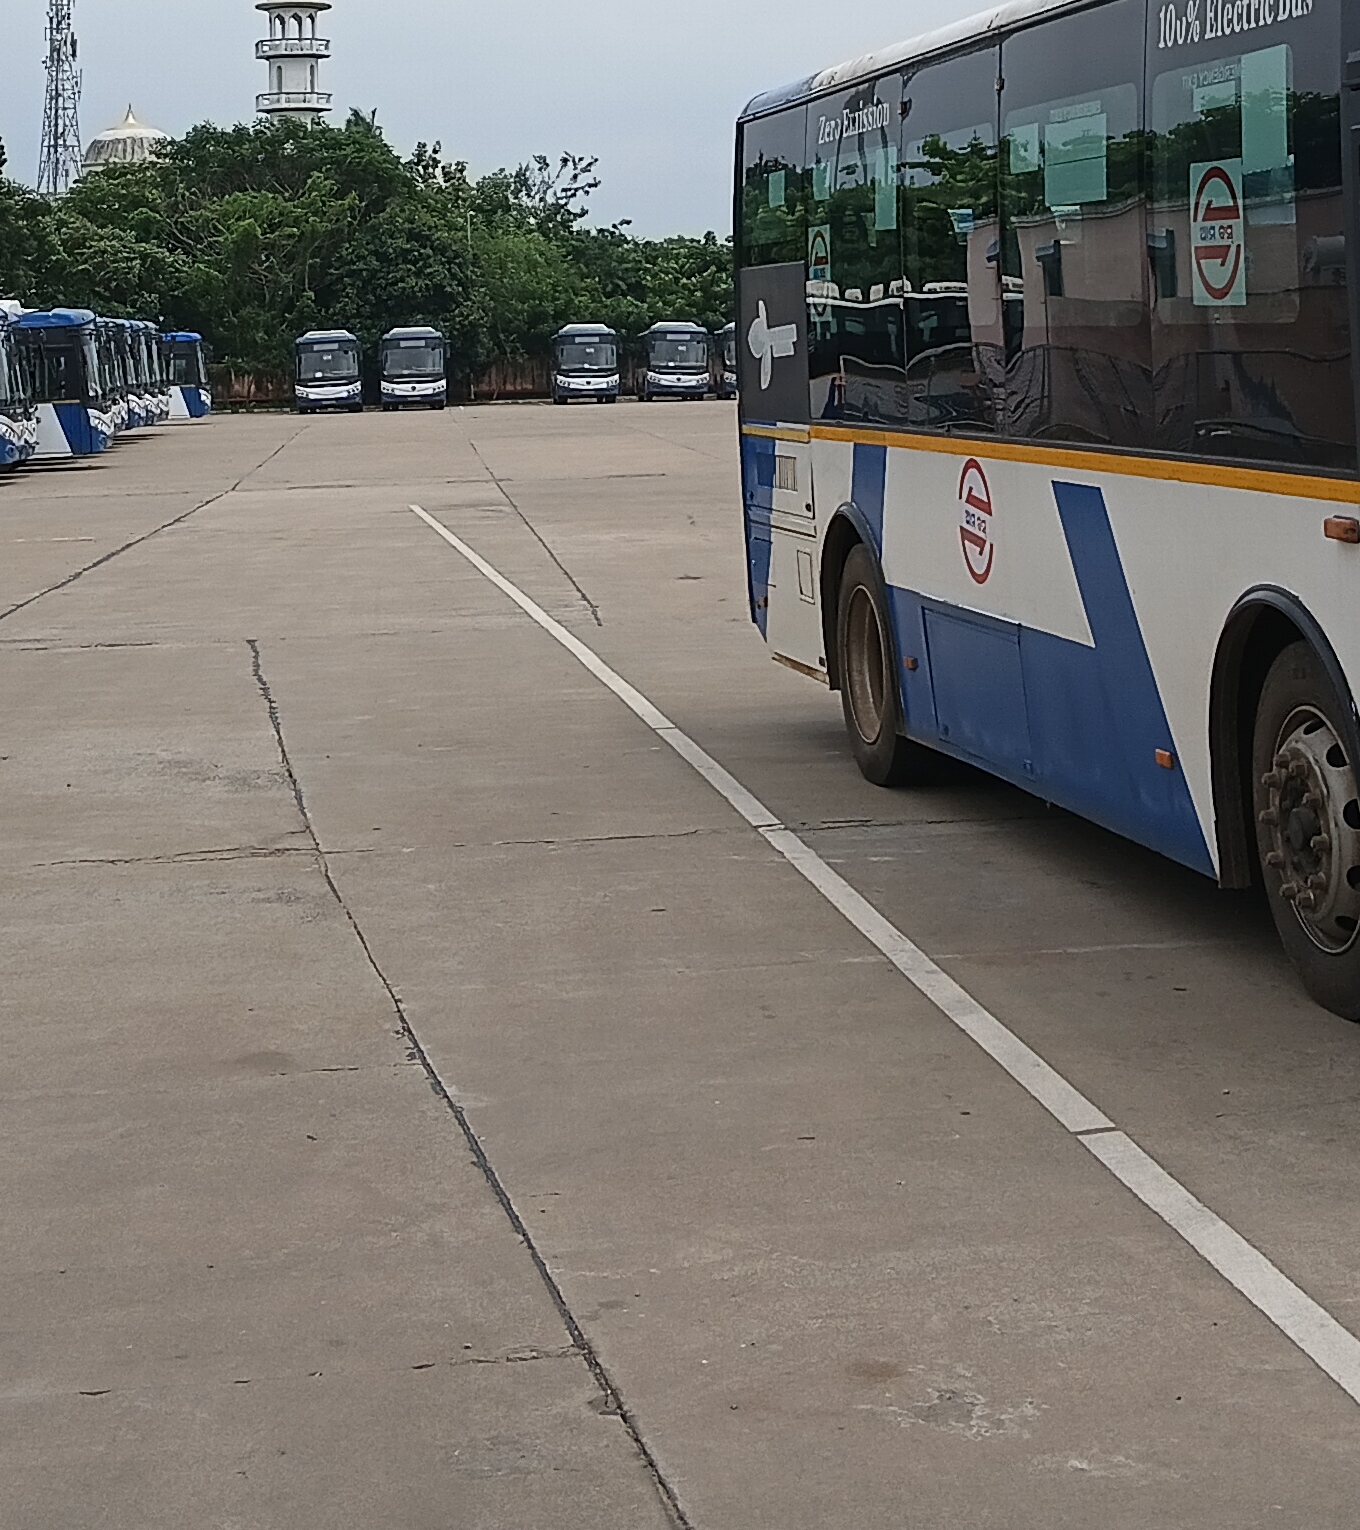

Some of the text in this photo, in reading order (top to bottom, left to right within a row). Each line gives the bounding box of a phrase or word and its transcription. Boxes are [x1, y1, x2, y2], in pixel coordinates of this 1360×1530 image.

[1158, 0, 1200, 48] 100%
[818, 94, 890, 144] Zero Emission
